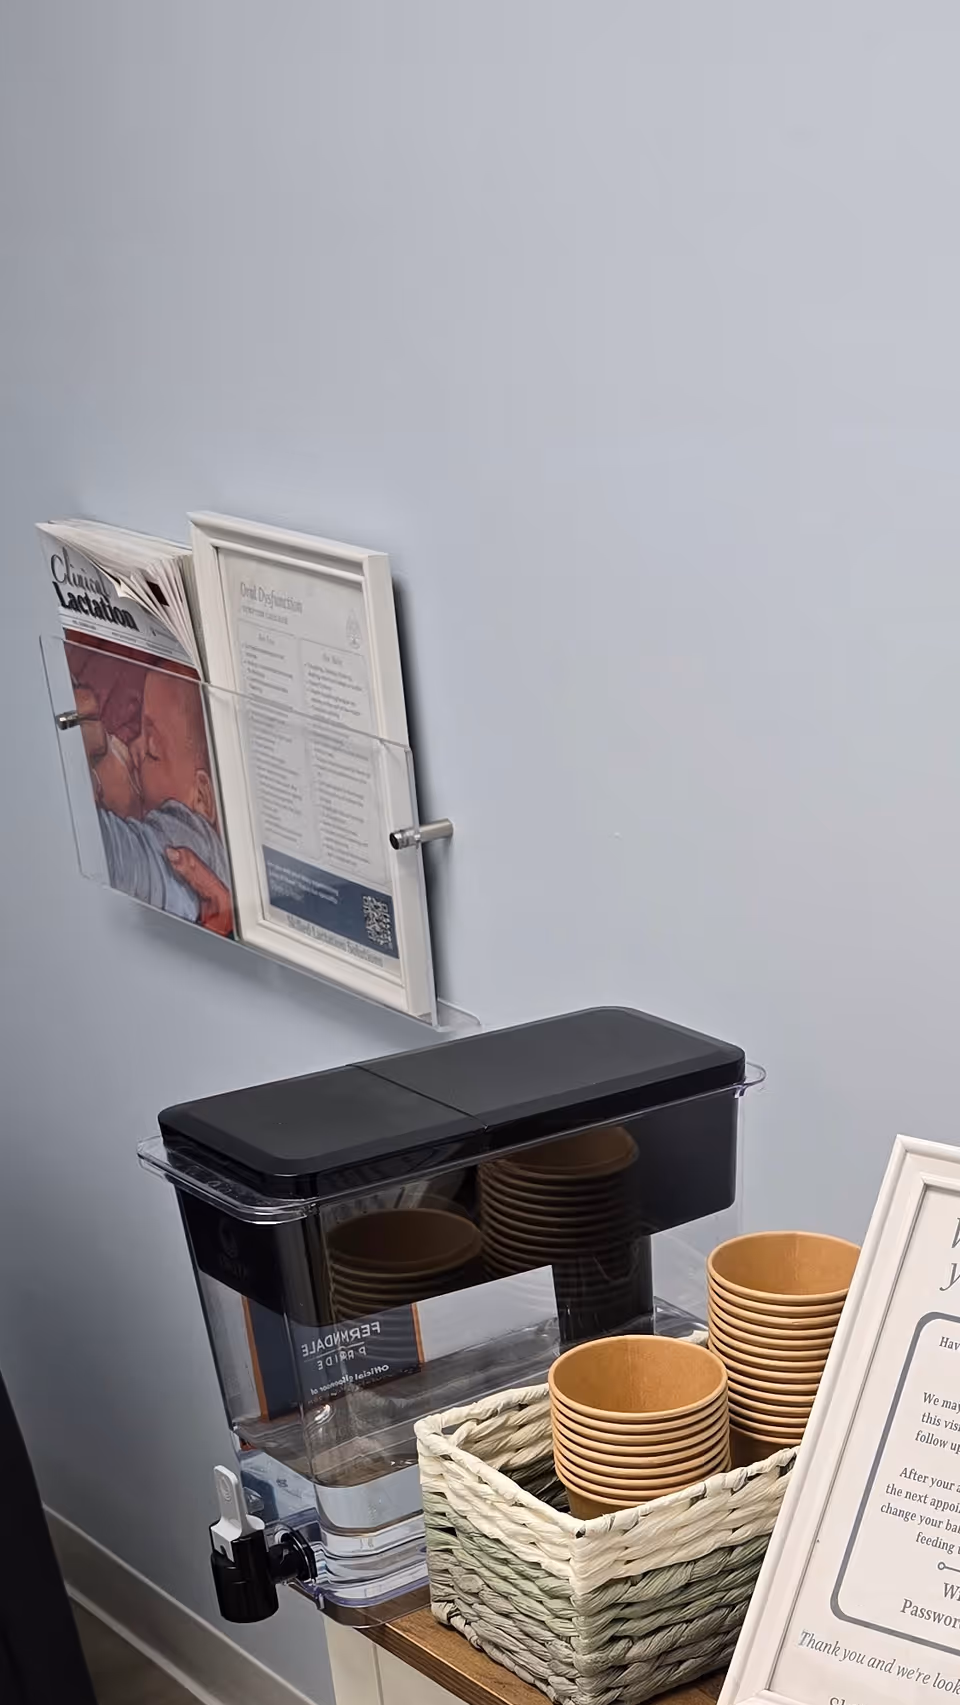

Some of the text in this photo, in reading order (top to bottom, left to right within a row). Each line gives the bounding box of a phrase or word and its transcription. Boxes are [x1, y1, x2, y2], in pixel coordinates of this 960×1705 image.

[52, 582, 139, 631] Lactation
[923, 1391, 940, 1406] We
[921, 1412, 942, 1427] this
[914, 1429, 949, 1449] follow
[899, 1467, 930, 1484] After
[928, 1477, 956, 1491] your
[885, 1483, 903, 1497] the
[903, 1490, 930, 1505] next
[880, 1502, 917, 1523] change
[917, 1514, 944, 1529] your
[915, 1531, 956, 1555] feeding
[798, 1629, 841, 1657] Thank
[838, 1648, 866, 1665] you
[866, 1656, 897, 1674] and
[896, 1665, 931, 1685] we're
